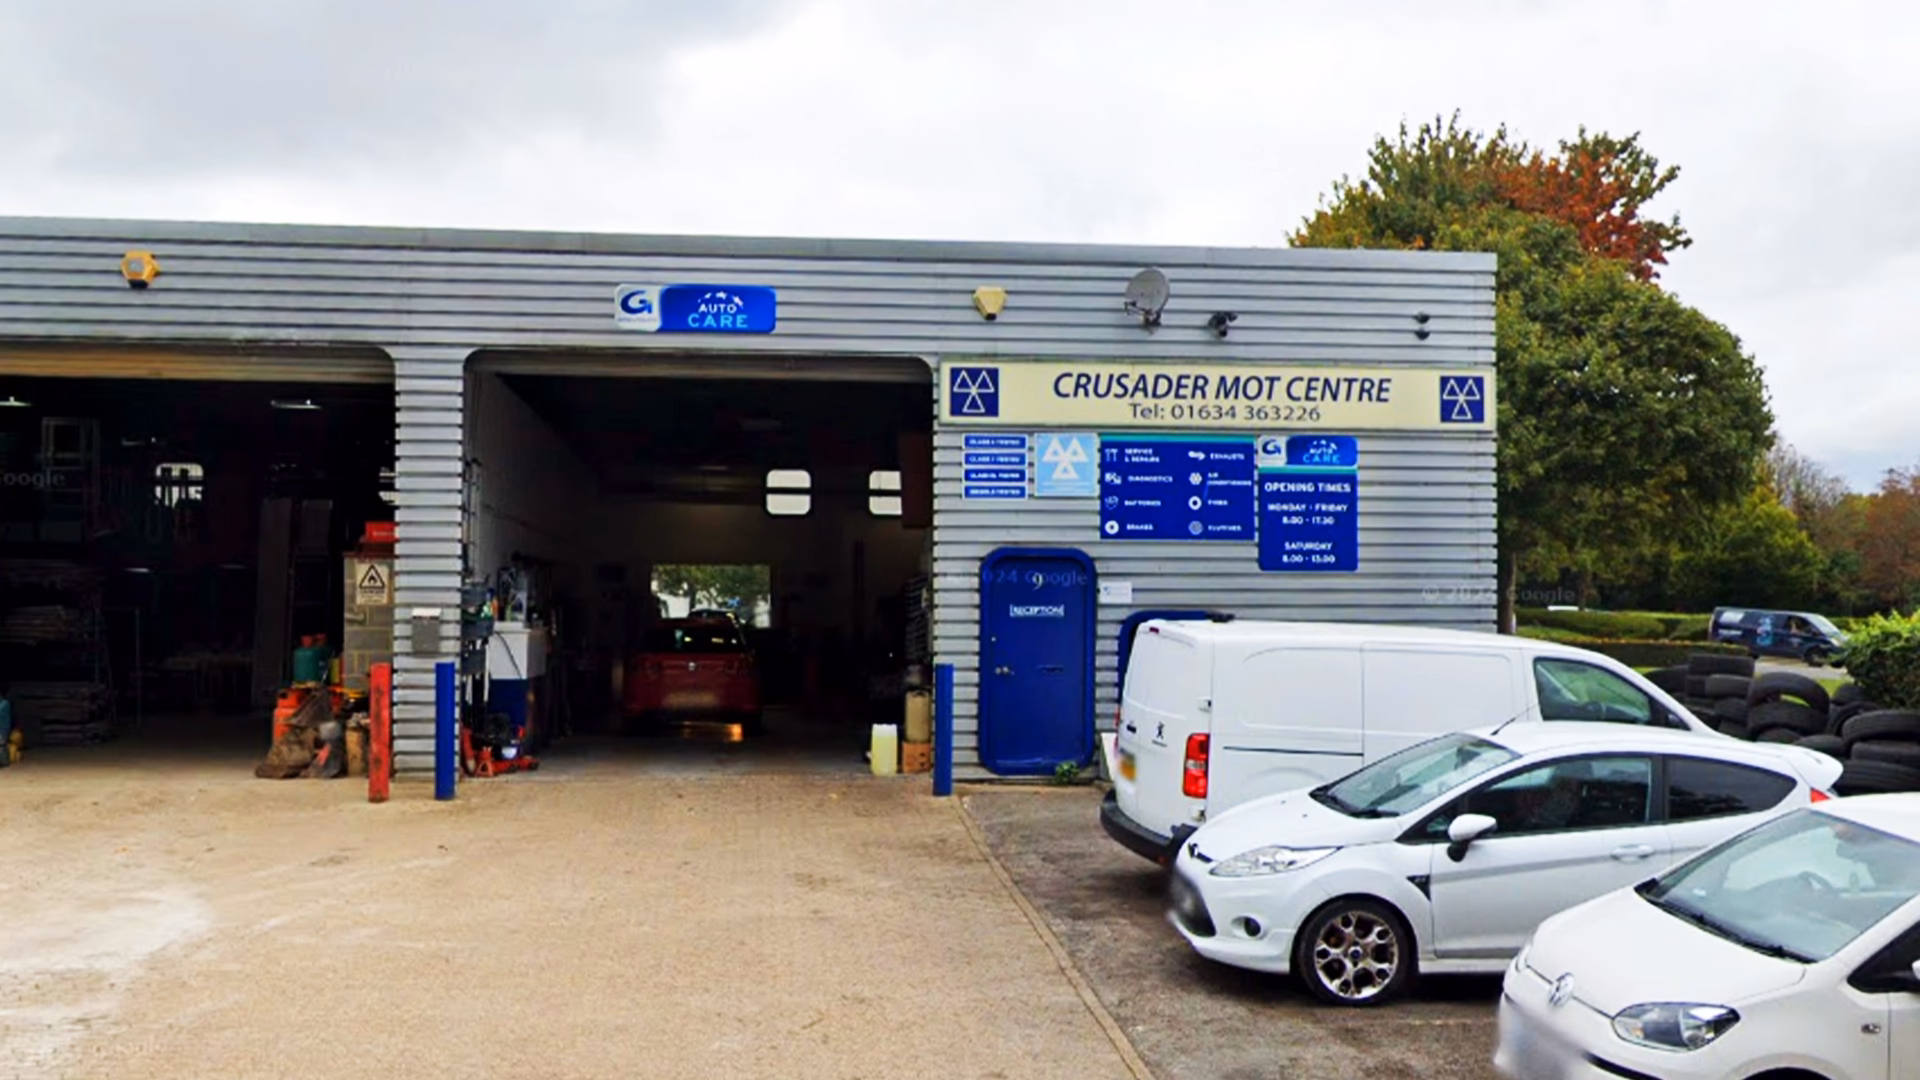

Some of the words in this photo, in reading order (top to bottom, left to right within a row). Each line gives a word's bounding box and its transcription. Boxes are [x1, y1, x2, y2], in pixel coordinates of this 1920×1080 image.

[698, 304, 737, 314] AUTO
[688, 313, 749, 329] CARE
[1053, 372, 1210, 400] CRUSADER
[1214, 375, 1282, 401] MOT
[1286, 376, 1392, 403] CENTRE
[1128, 402, 1166, 420] Tel:
[1171, 404, 1237, 420] 01634
[1243, 404, 1321, 421] 363226
[1264, 482, 1316, 493] OPENING
[1318, 482, 1352, 493] TIMES
[1267, 503, 1307, 512] MONDAY
[1315, 503, 1349, 512] FRIDAY
[1285, 541, 1333, 551] SATURDAY
